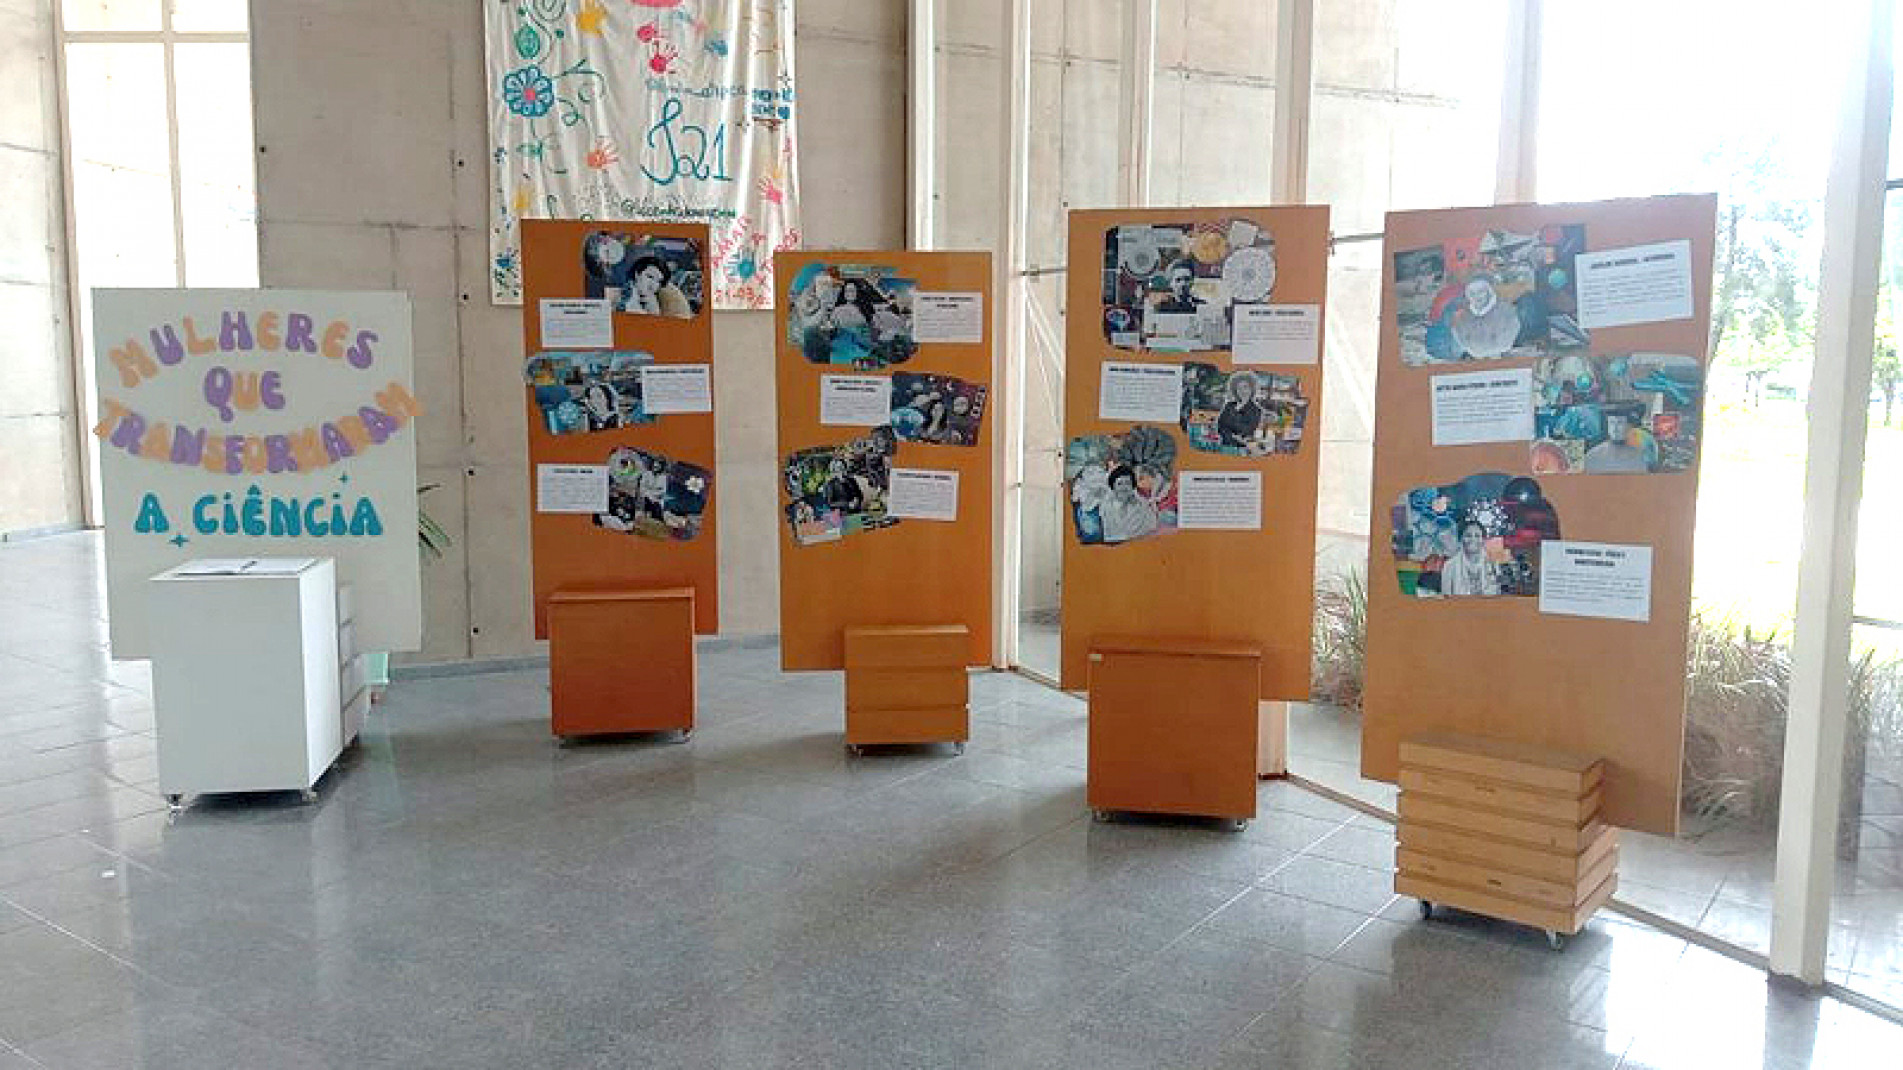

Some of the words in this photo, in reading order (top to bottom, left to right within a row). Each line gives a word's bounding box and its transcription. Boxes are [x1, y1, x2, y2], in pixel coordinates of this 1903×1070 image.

[109, 311, 379, 388] MULHERES
[204, 366, 286, 422] QUE
[93, 381, 428, 475] TRANSFORMARAM
[133, 492, 170, 534] A
